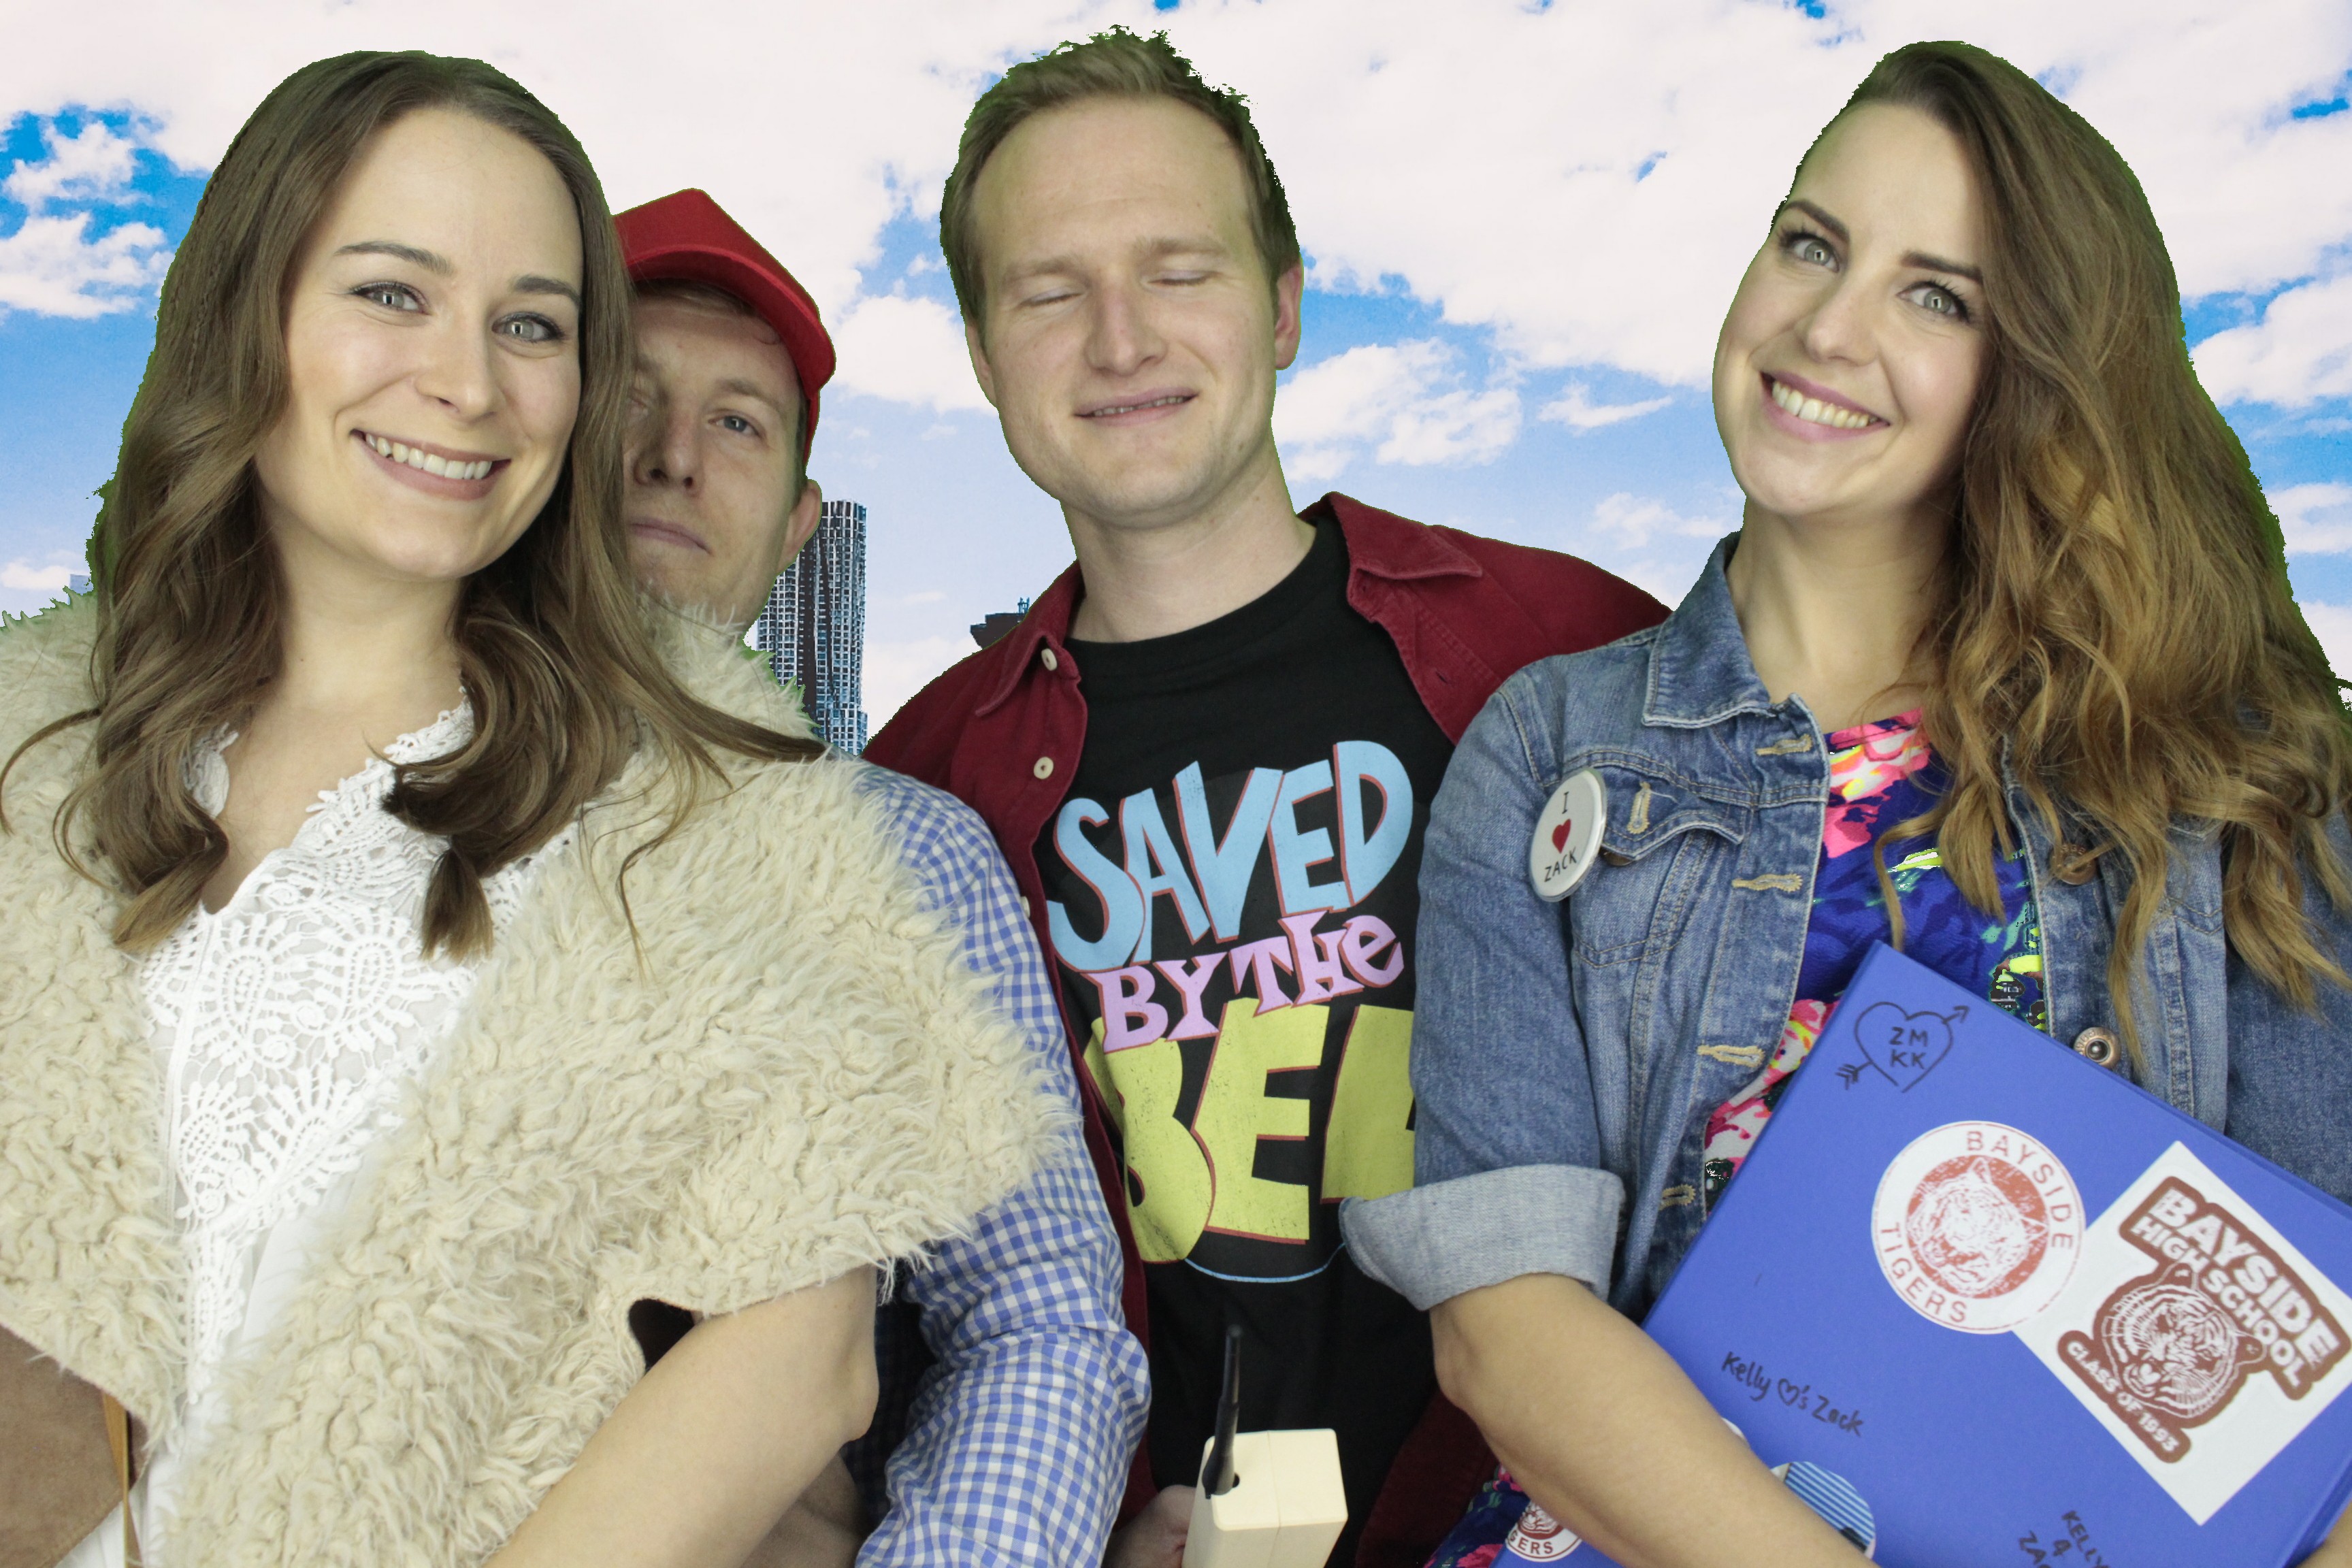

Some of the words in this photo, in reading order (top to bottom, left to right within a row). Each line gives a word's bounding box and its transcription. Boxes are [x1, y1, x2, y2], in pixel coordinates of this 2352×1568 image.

[1562, 791, 1569, 815] I
[1047, 740, 1414, 973] SAVED
[1544, 847, 1577, 883] ZACK
[1081, 951, 1228, 1054] BY
[1890, 1049, 1926, 1069] KK
[1966, 1130, 2074, 1250] BAYSIDE
[1880, 1222, 1967, 1323] TIGERS
[2130, 1216, 2210, 1275] HIGH
[2202, 1269, 2305, 1388] SCHOOL
[2148, 1188, 2340, 1370] BAYSIDE
[1721, 1351, 1771, 1401] Kelly
[1812, 1394, 1863, 1437] Zack
[2067, 1341, 2121, 1393] CLASS
[2117, 1392, 2144, 1416] OF
[2138, 1411, 2178, 1452] 1993
[2019, 1530, 2052, 1568] ZA
